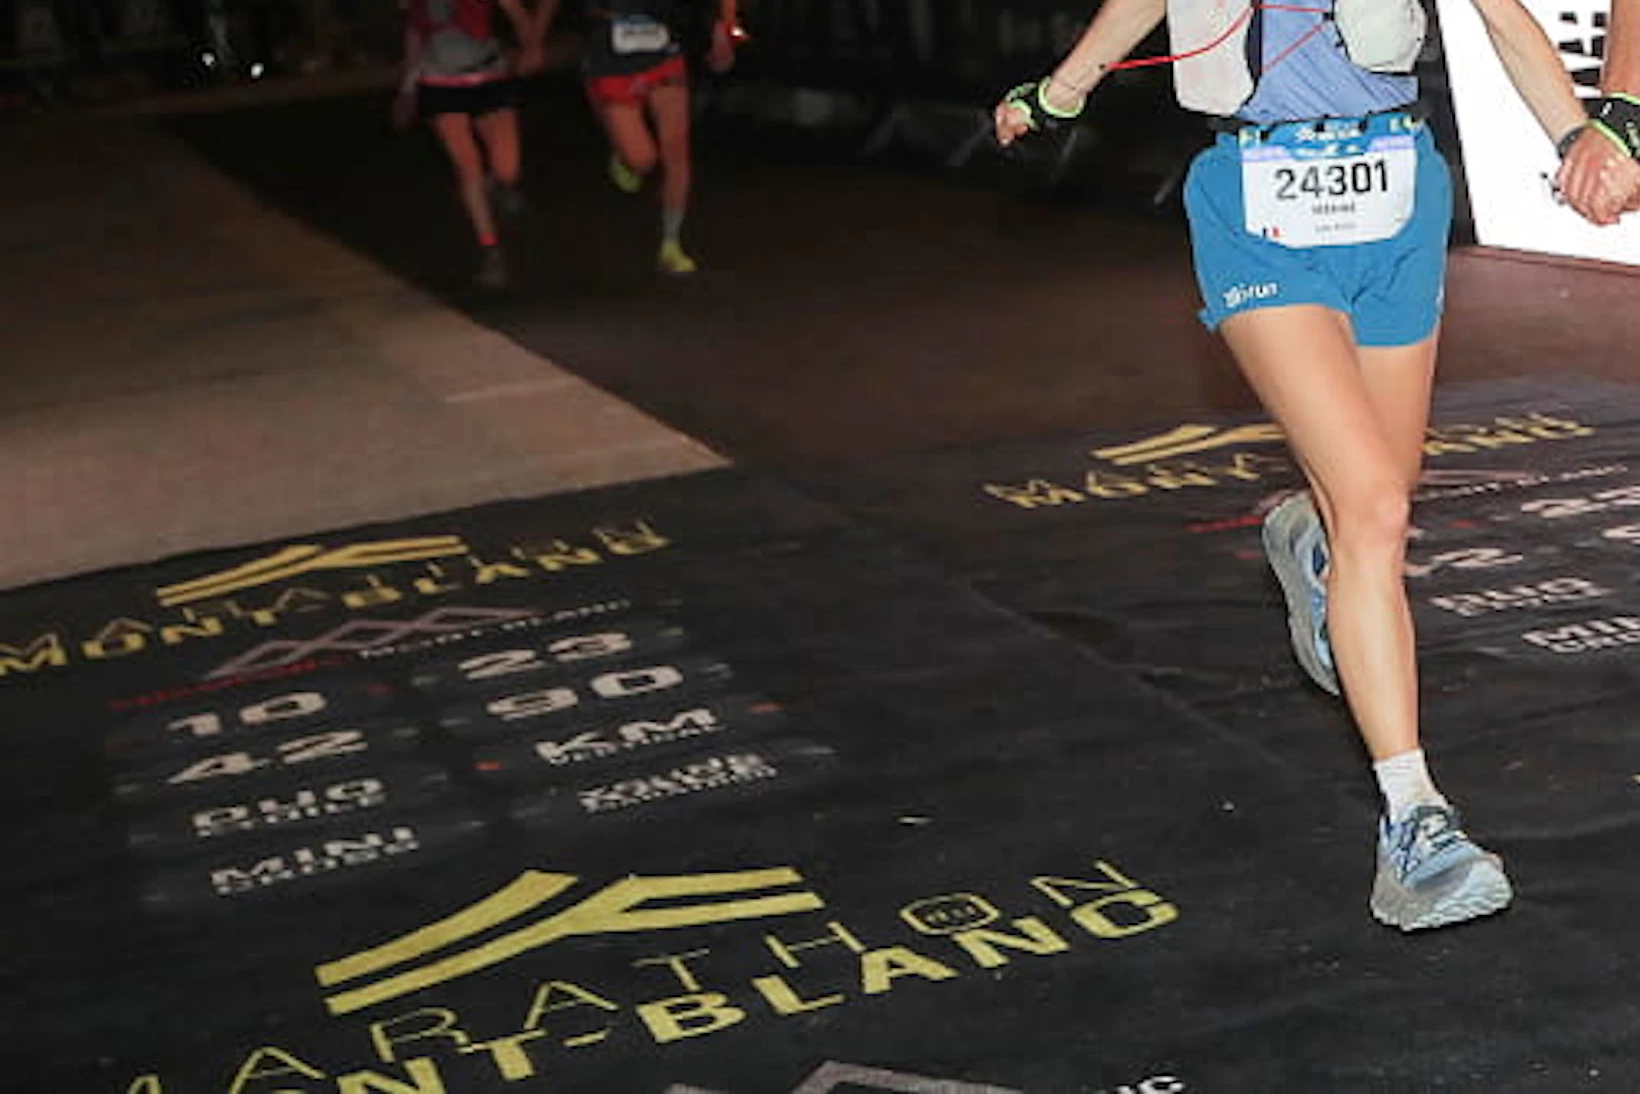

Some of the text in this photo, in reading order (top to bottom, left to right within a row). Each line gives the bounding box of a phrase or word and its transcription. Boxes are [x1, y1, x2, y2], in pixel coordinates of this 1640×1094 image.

[1274, 159, 1389, 201] 24301
[167, 690, 327, 737] 10
[486, 664, 684, 721] 90
[167, 729, 369, 785] 42
